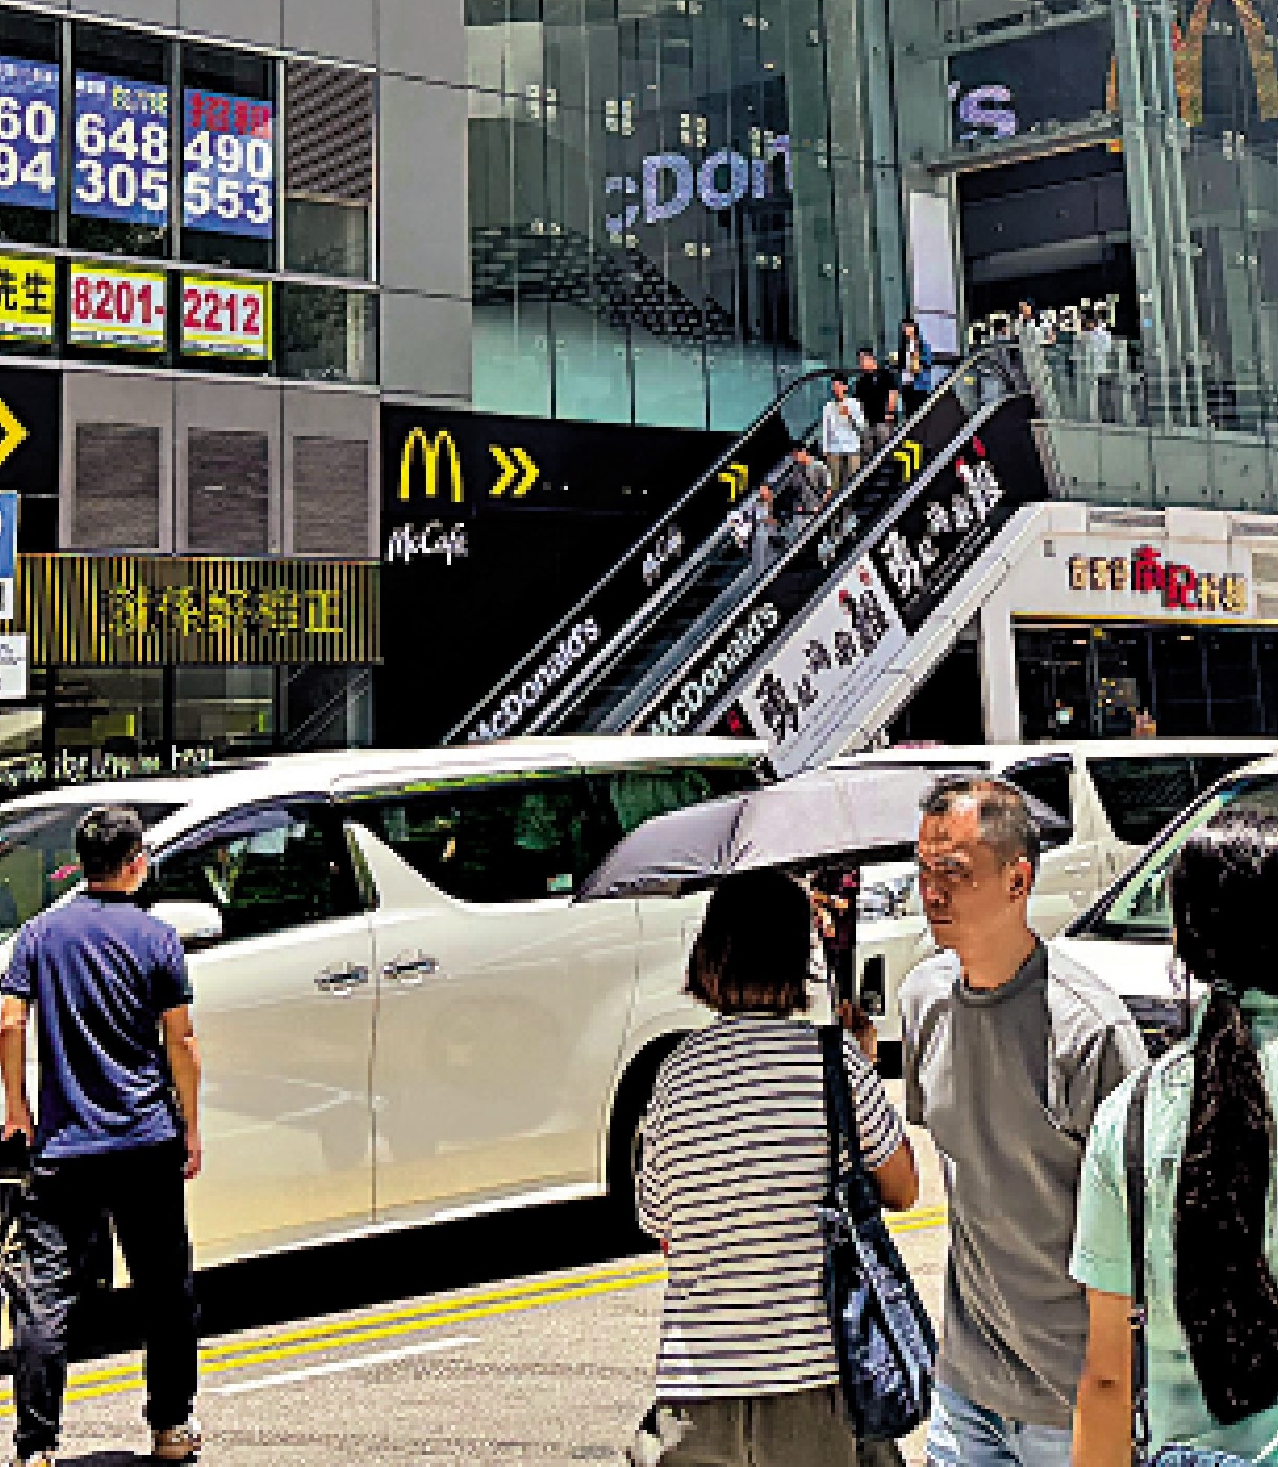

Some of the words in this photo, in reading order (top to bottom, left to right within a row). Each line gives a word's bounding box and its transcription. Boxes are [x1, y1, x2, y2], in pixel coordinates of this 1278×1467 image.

[75, 114, 166, 165] 648
[183, 131, 272, 179] 490
[75, 160, 166, 212] 305
[183, 176, 271, 224] 553
[182, 288, 262, 336] 2212
